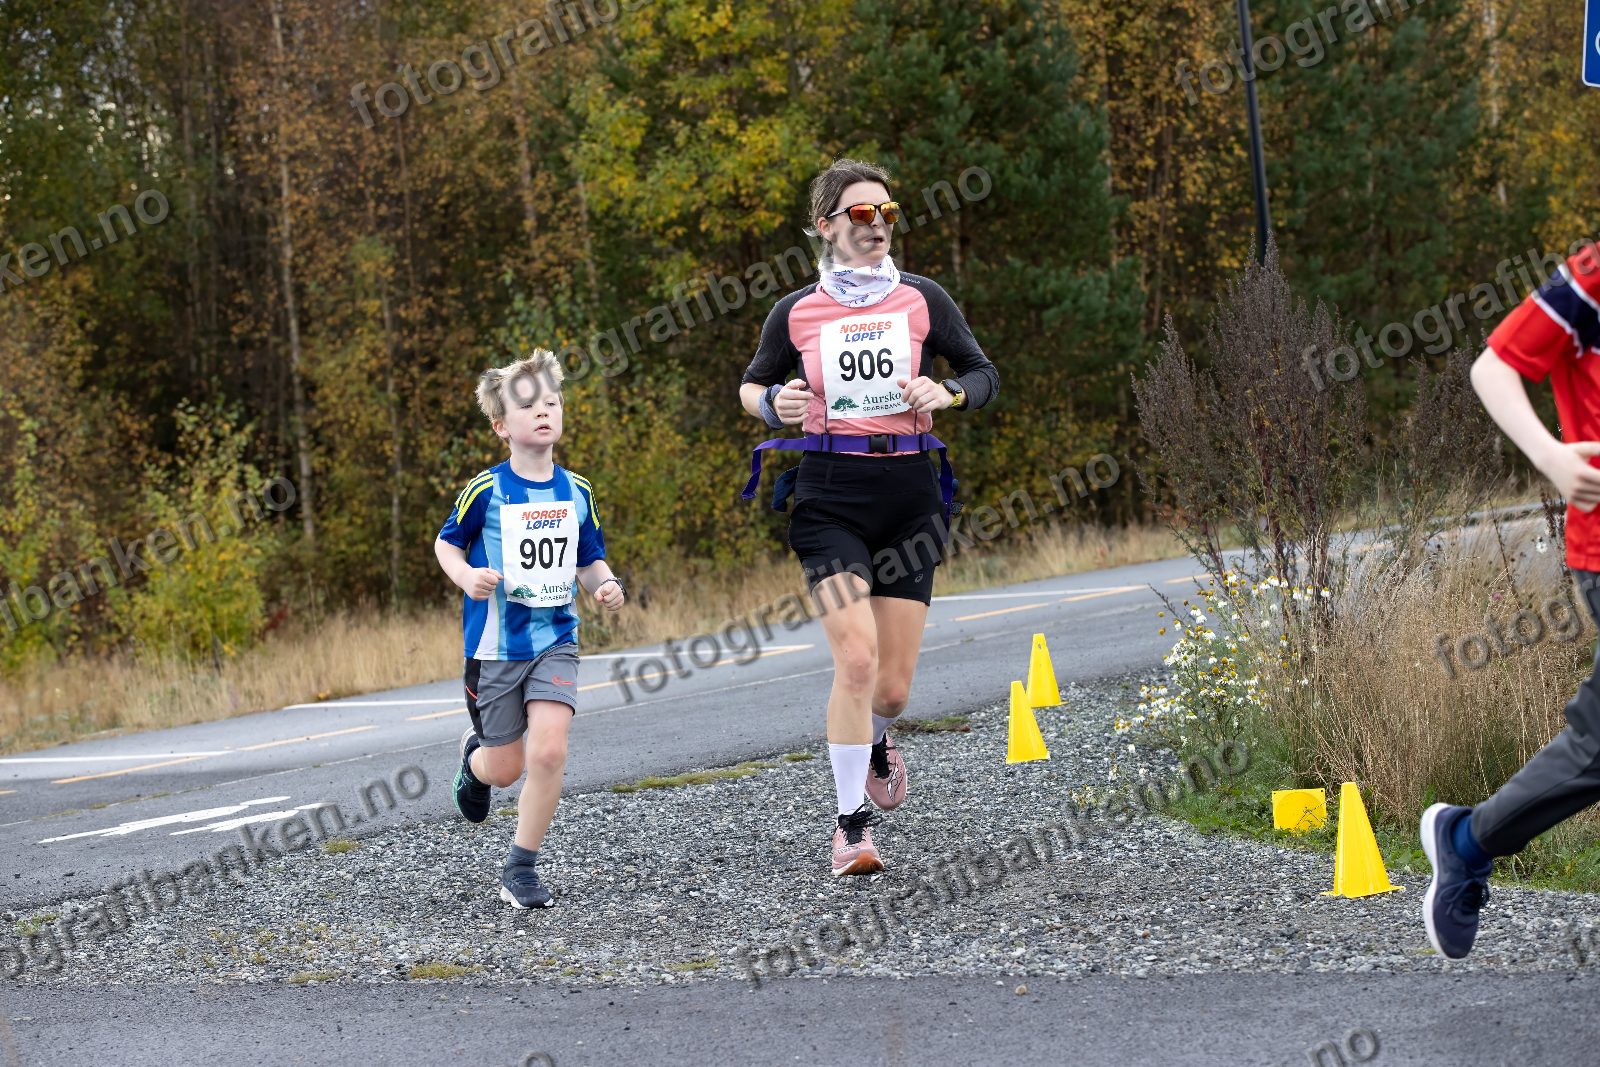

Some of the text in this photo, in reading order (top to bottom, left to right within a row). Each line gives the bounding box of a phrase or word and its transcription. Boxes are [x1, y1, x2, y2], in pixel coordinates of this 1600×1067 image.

[840, 321, 892, 333] NORGES
[845, 331, 884, 342] LØPET
[839, 348, 893, 381] 906
[522, 509, 567, 520] NORGES
[526, 519, 562, 530] LØPET
[520, 537, 568, 569] 907
